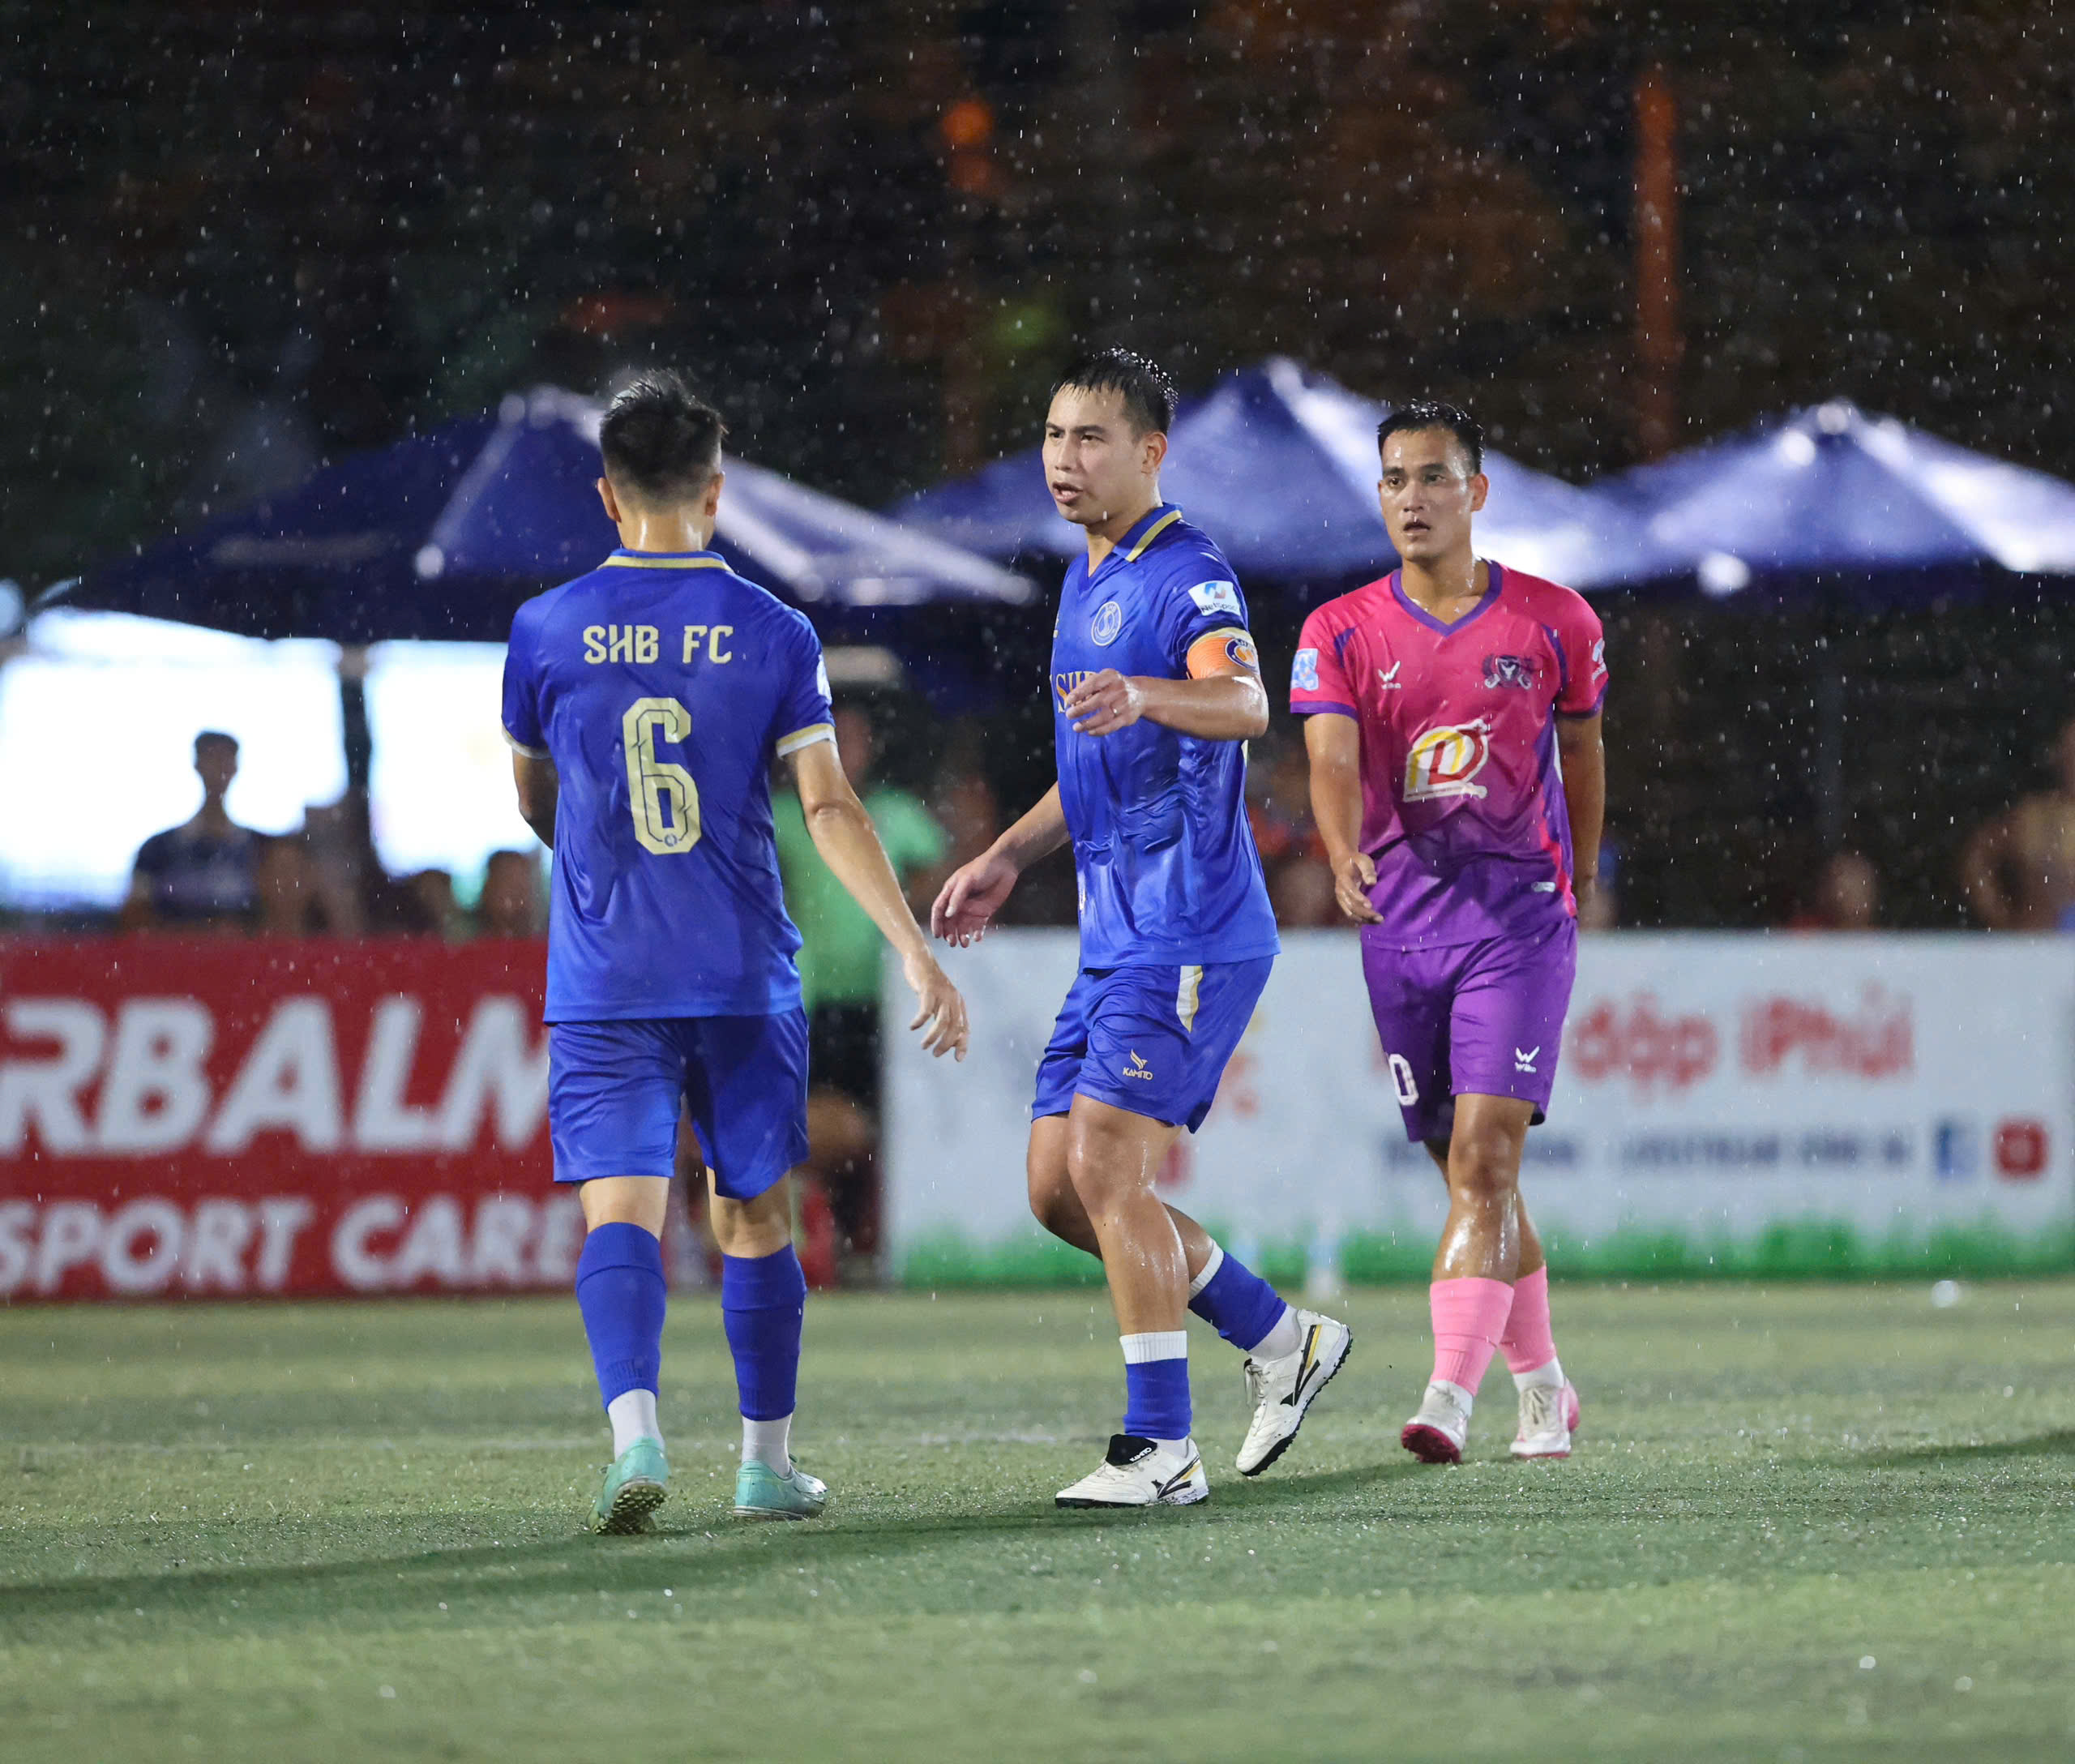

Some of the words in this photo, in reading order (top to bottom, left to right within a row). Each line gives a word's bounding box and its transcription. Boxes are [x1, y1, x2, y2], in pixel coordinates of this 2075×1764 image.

[582, 624, 659, 665] SHB
[682, 624, 734, 665] FC
[622, 697, 702, 855] 6
[1123, 1067, 1153, 1081] KAMITO
